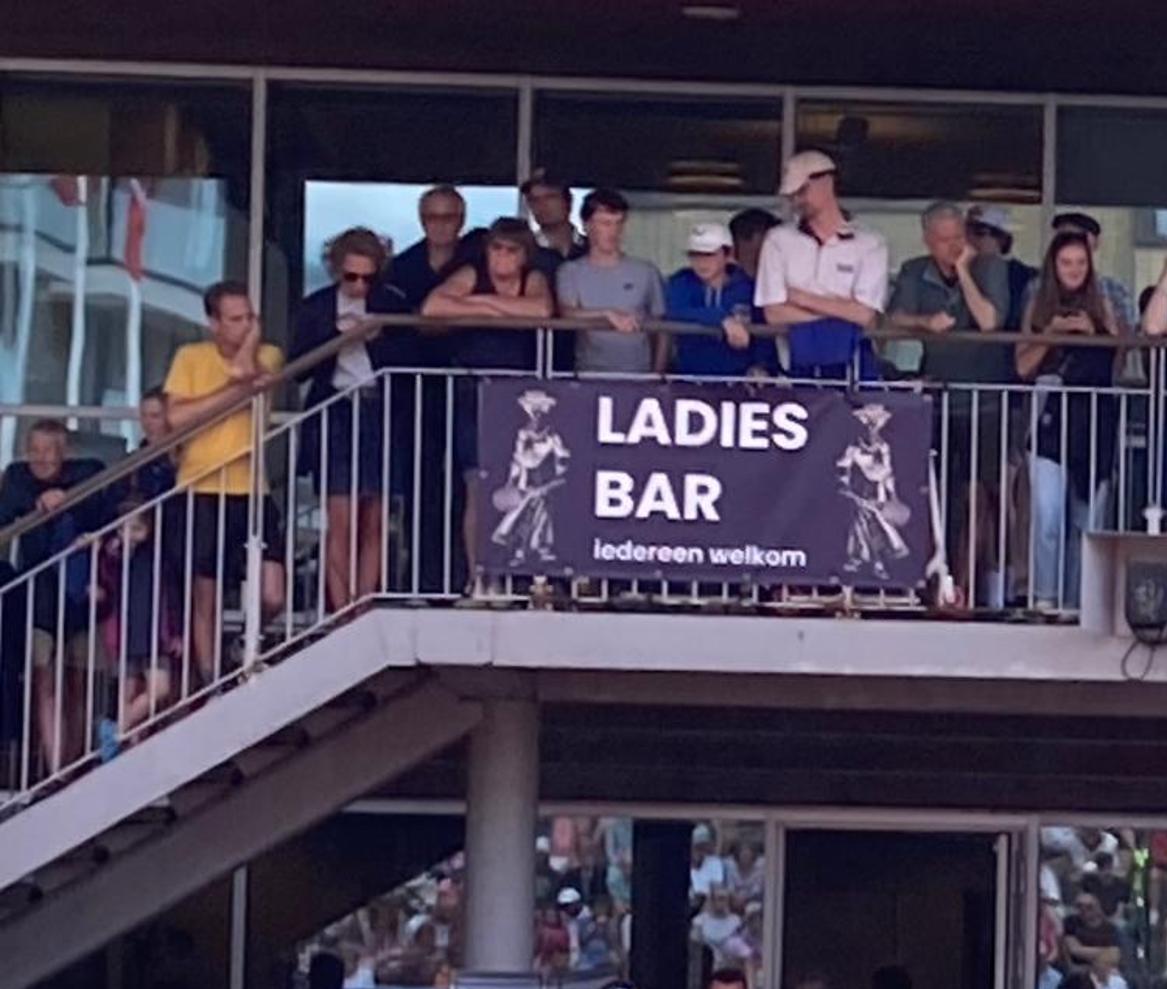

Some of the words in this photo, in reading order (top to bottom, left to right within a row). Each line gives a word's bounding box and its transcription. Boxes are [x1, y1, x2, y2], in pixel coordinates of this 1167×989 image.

[596, 396, 810, 451] LADIES
[594, 470, 723, 521] BAR
[708, 545, 807, 568] welkom
